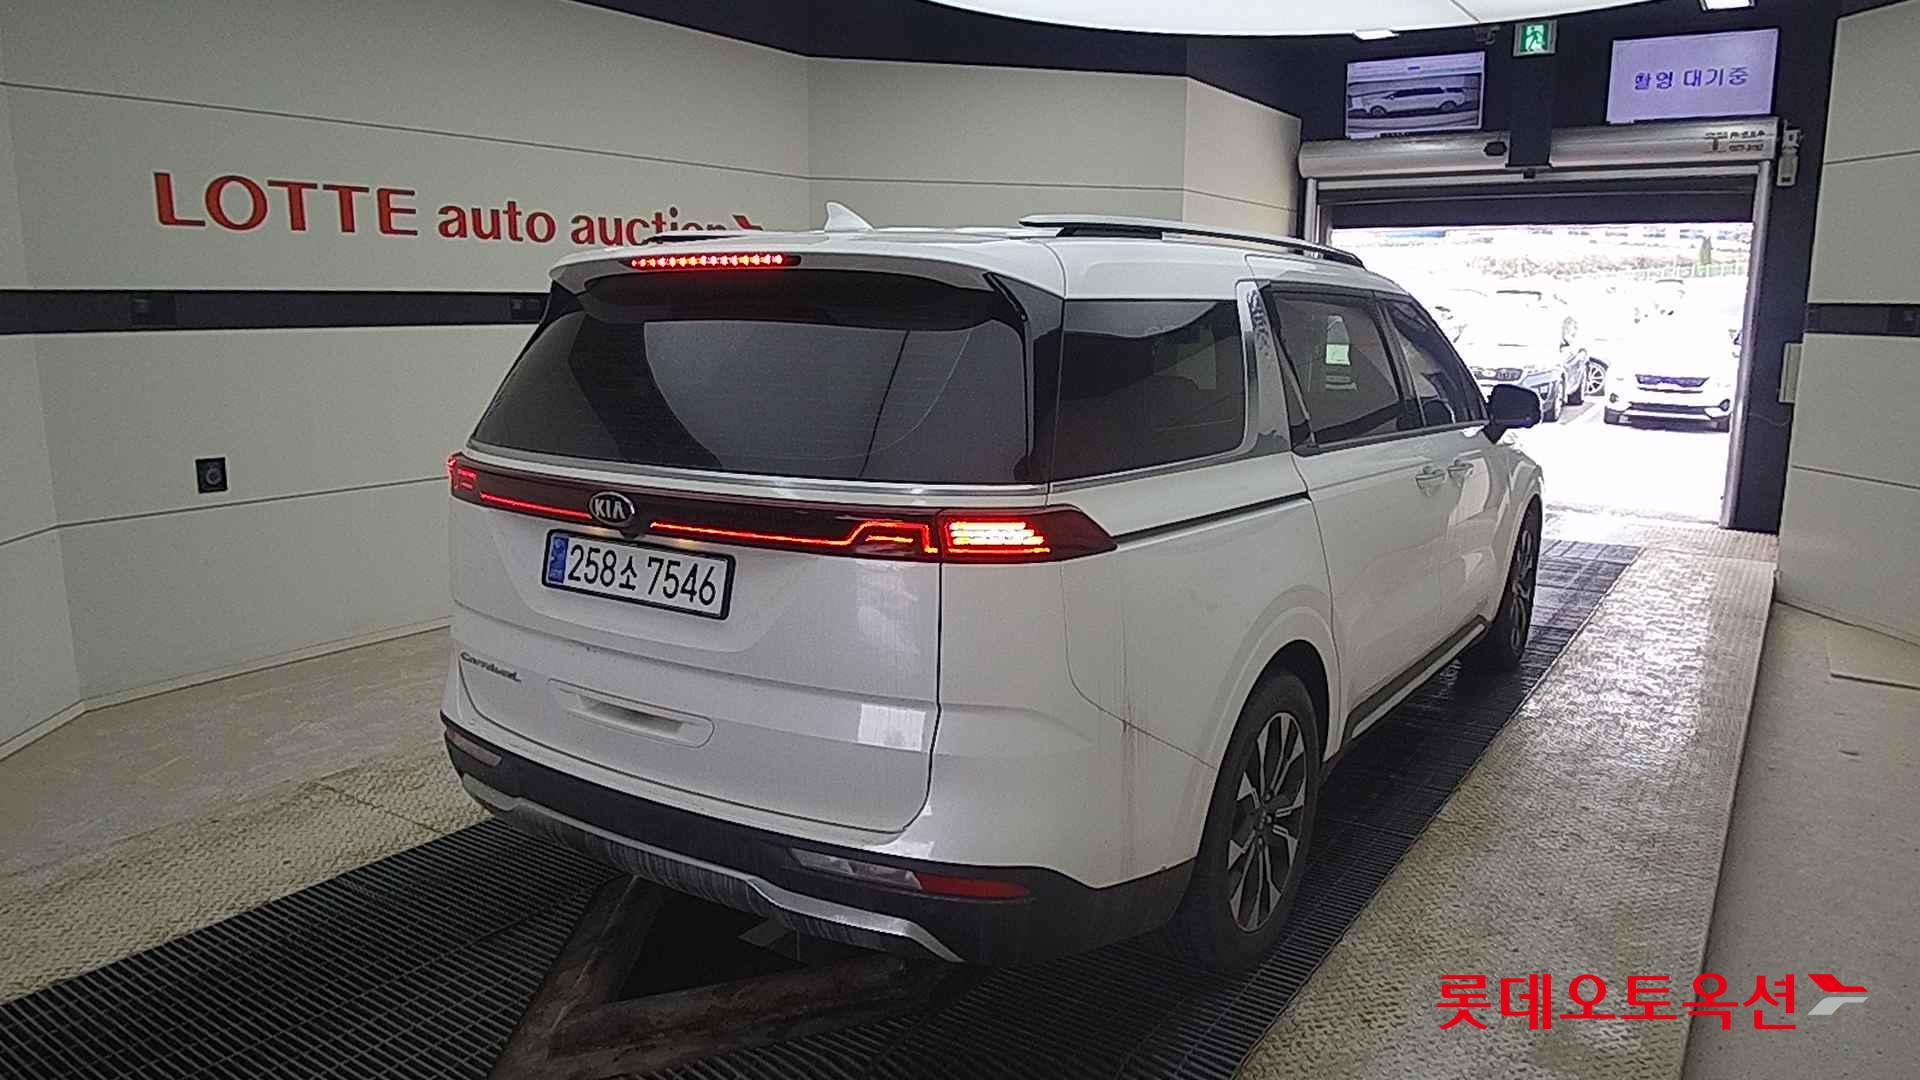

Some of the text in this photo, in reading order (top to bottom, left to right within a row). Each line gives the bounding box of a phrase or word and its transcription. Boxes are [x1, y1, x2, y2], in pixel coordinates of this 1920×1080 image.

[1682, 66, 1749, 87] 대기중
[153, 171, 418, 236] LOTTE
[438, 200, 556, 243] auto
[594, 498, 626, 520] KIA
[567, 544, 716, 606] 258소 7546
